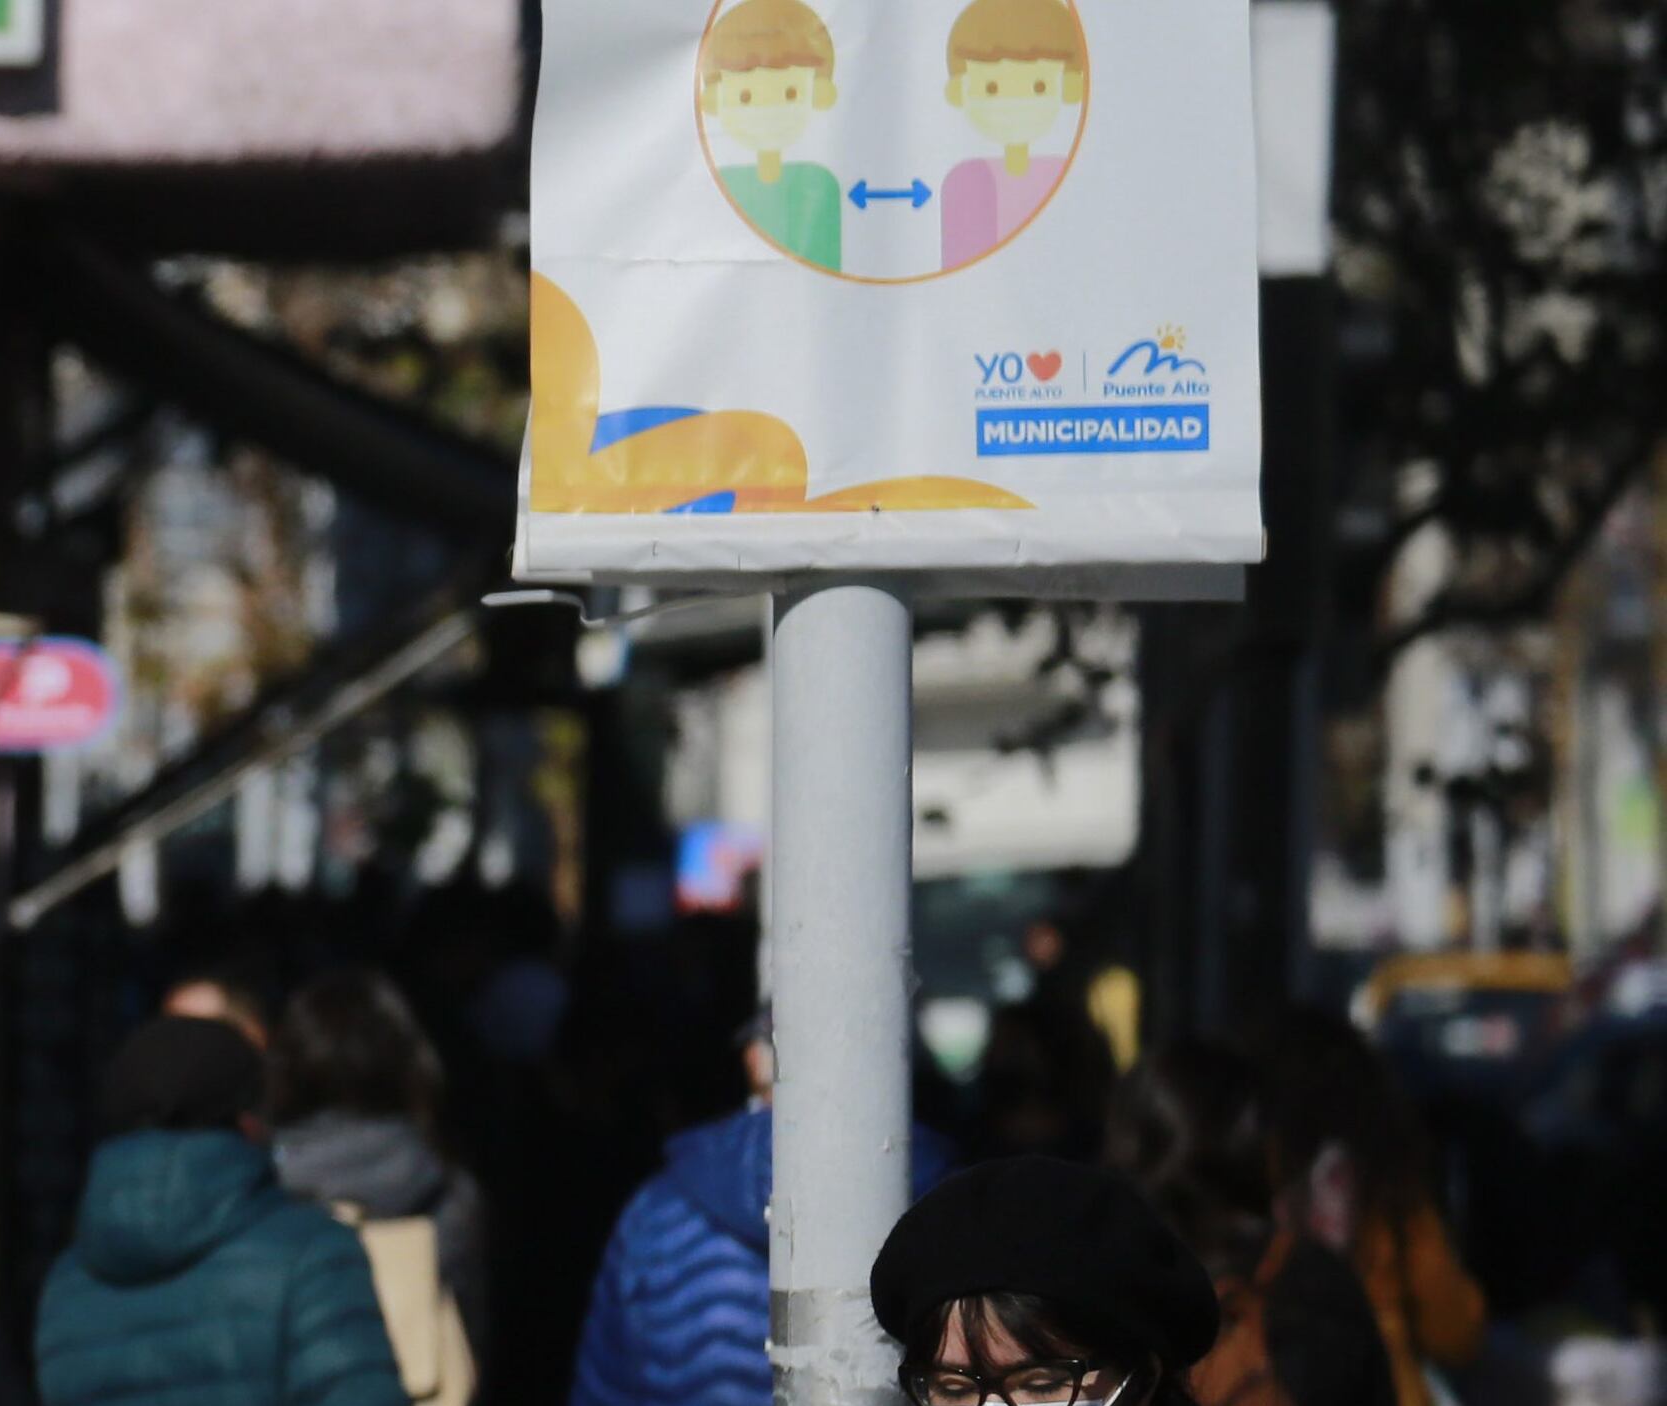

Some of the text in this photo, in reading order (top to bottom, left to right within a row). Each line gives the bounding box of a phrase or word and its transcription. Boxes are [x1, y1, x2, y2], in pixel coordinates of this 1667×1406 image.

[974, 352, 1023, 384] YO
[975, 386, 1063, 399] PUENTE ALTO
[1104, 381, 1209, 397] Puente Alto
[983, 416, 1203, 445] MUNICIPALIDAD
